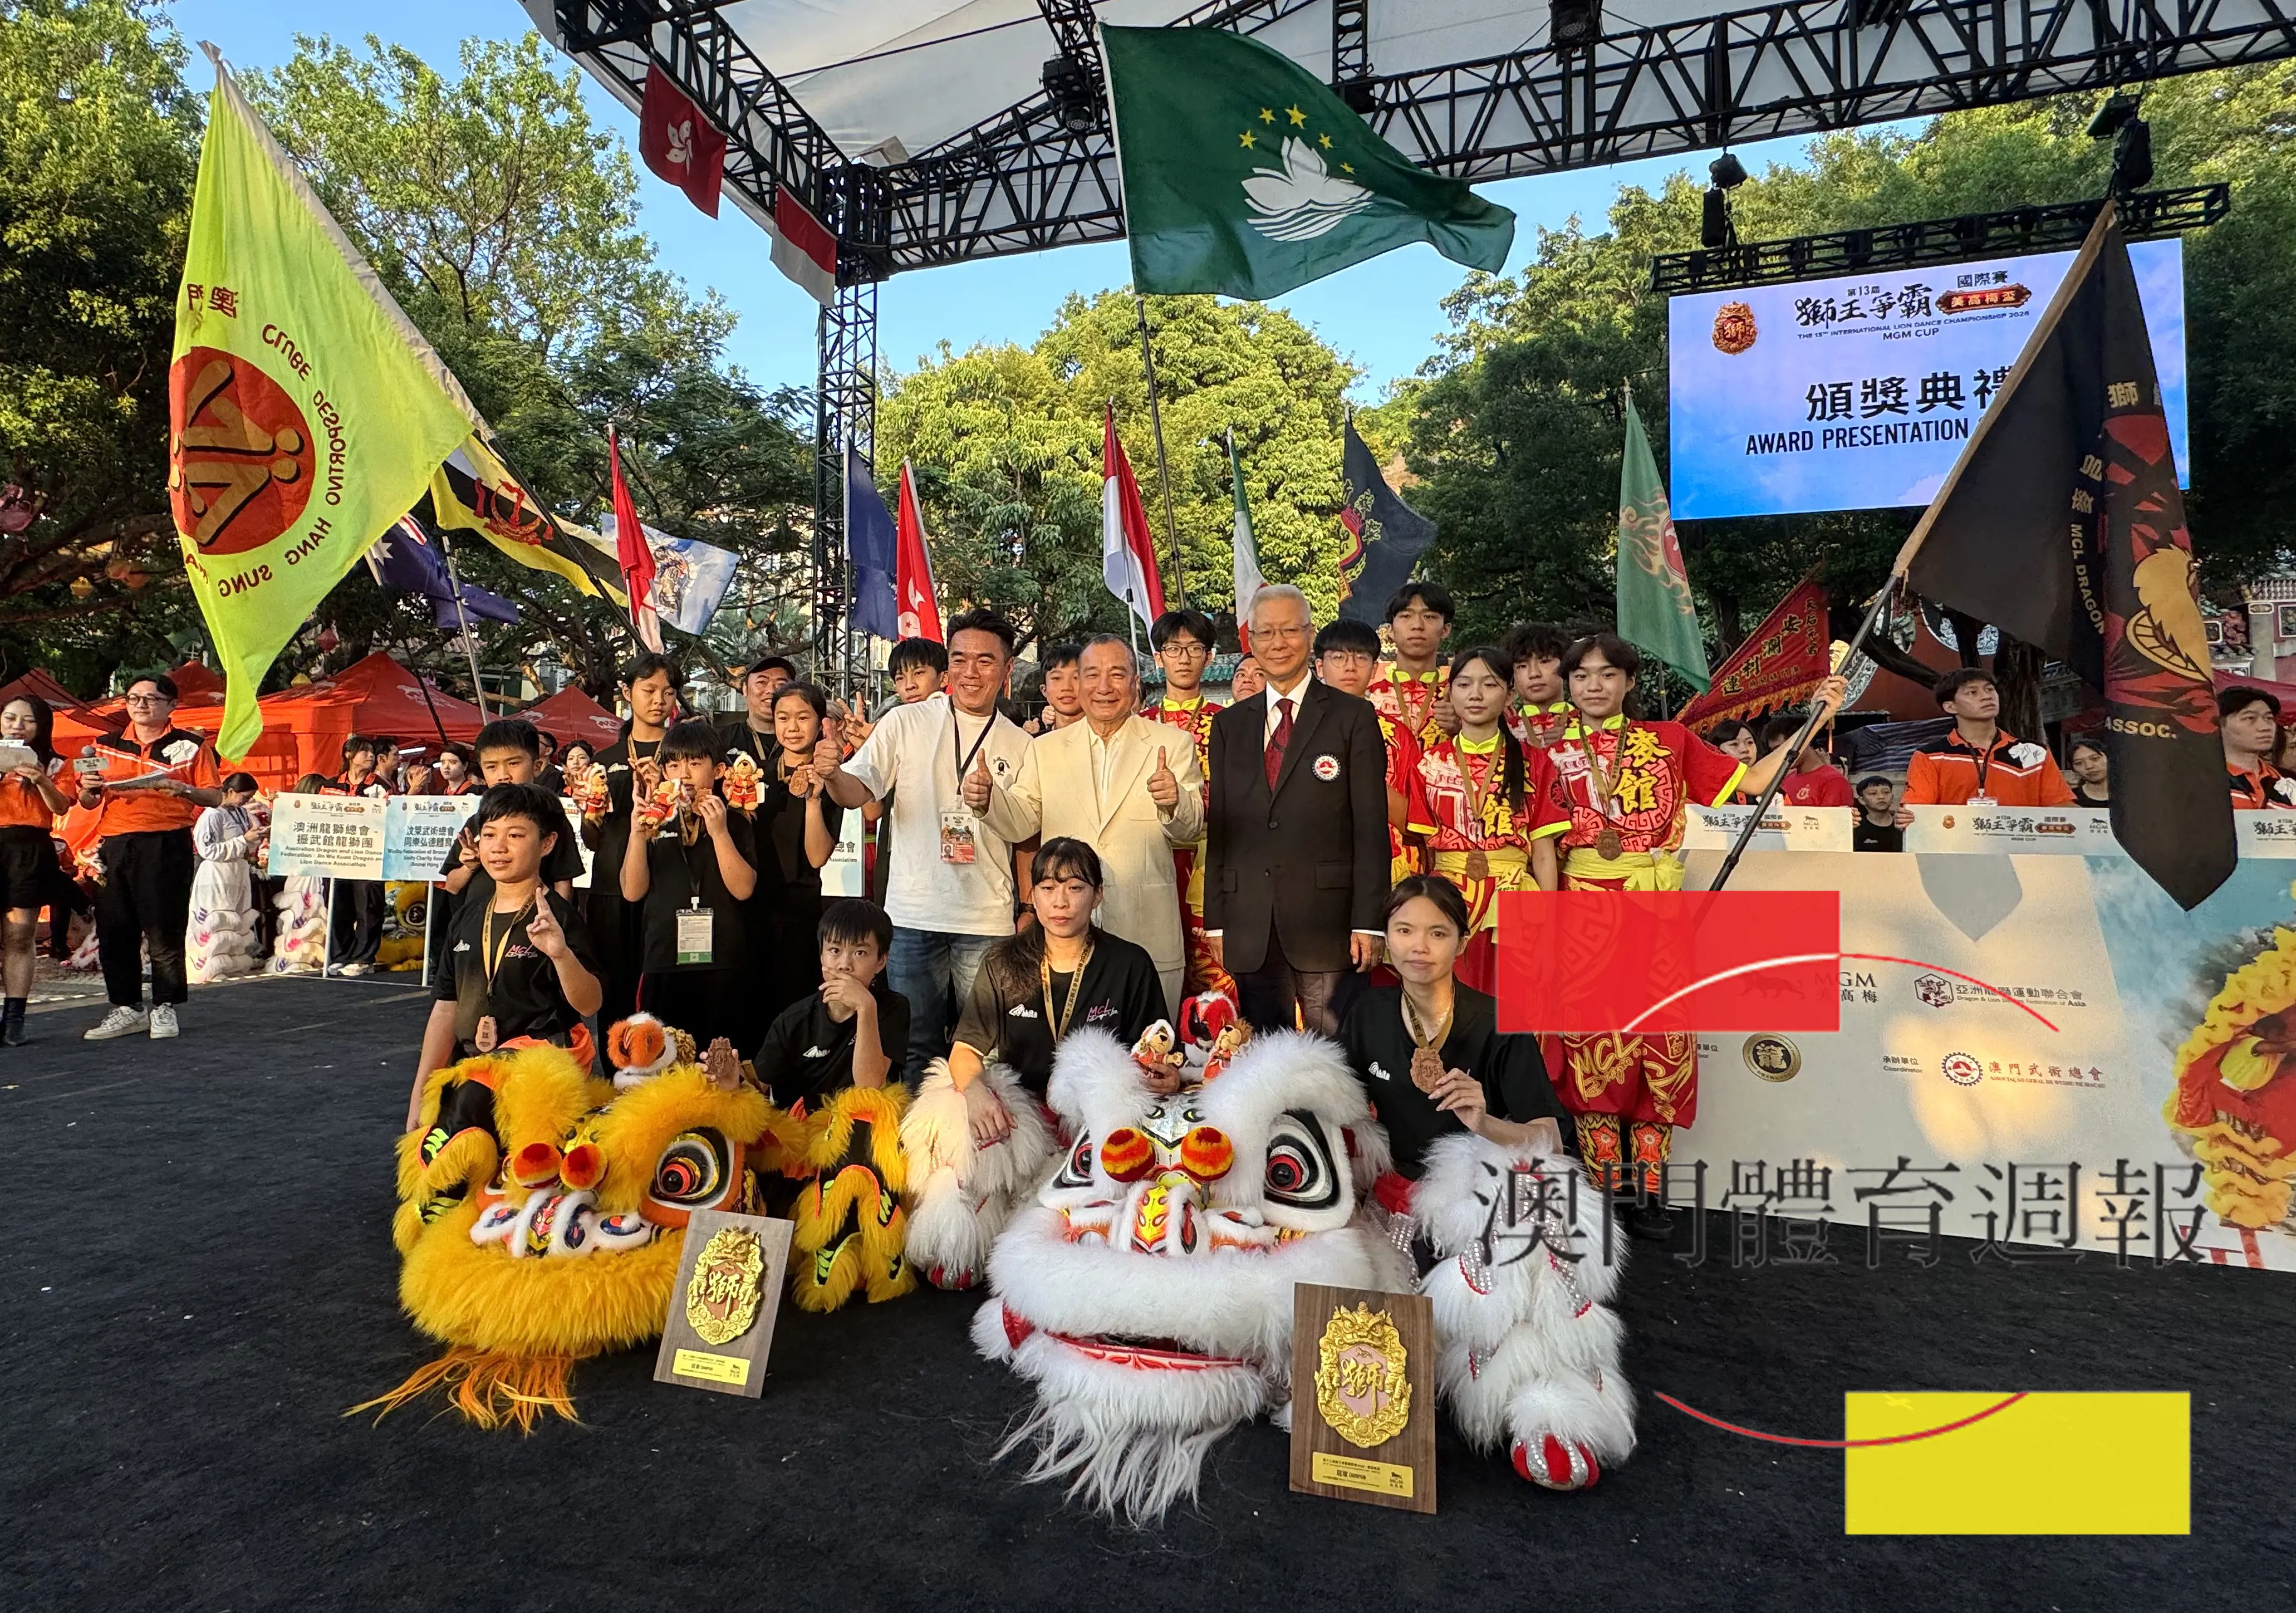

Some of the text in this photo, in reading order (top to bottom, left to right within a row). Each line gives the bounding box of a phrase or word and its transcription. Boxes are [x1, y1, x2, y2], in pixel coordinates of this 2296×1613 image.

[1957, 271, 2008, 288] 國際賽
[1794, 283, 1933, 330] 獅王爭霸
[1830, 324, 1891, 337] INTERNATIONAL
[1893, 322, 1912, 330] LION
[1914, 319, 1942, 328] DANCE
[1943, 313, 2006, 325] CHAMPIONSHIP
[1883, 327, 1940, 341] MGM CUP
[2108, 381, 2139, 408] 獅
[1745, 417, 1969, 455] AWARD PRESENTATION
[2071, 524, 2104, 634] MCL DRAGON
[1611, 727, 1672, 814] 麥館
[1574, 1030, 1643, 1103] MCL
[1883, 1056, 1919, 1065] 承辦單位
[1989, 1062, 2104, 1081] 澳門武術總會
[1340, 1357, 1385, 1418] 獅
